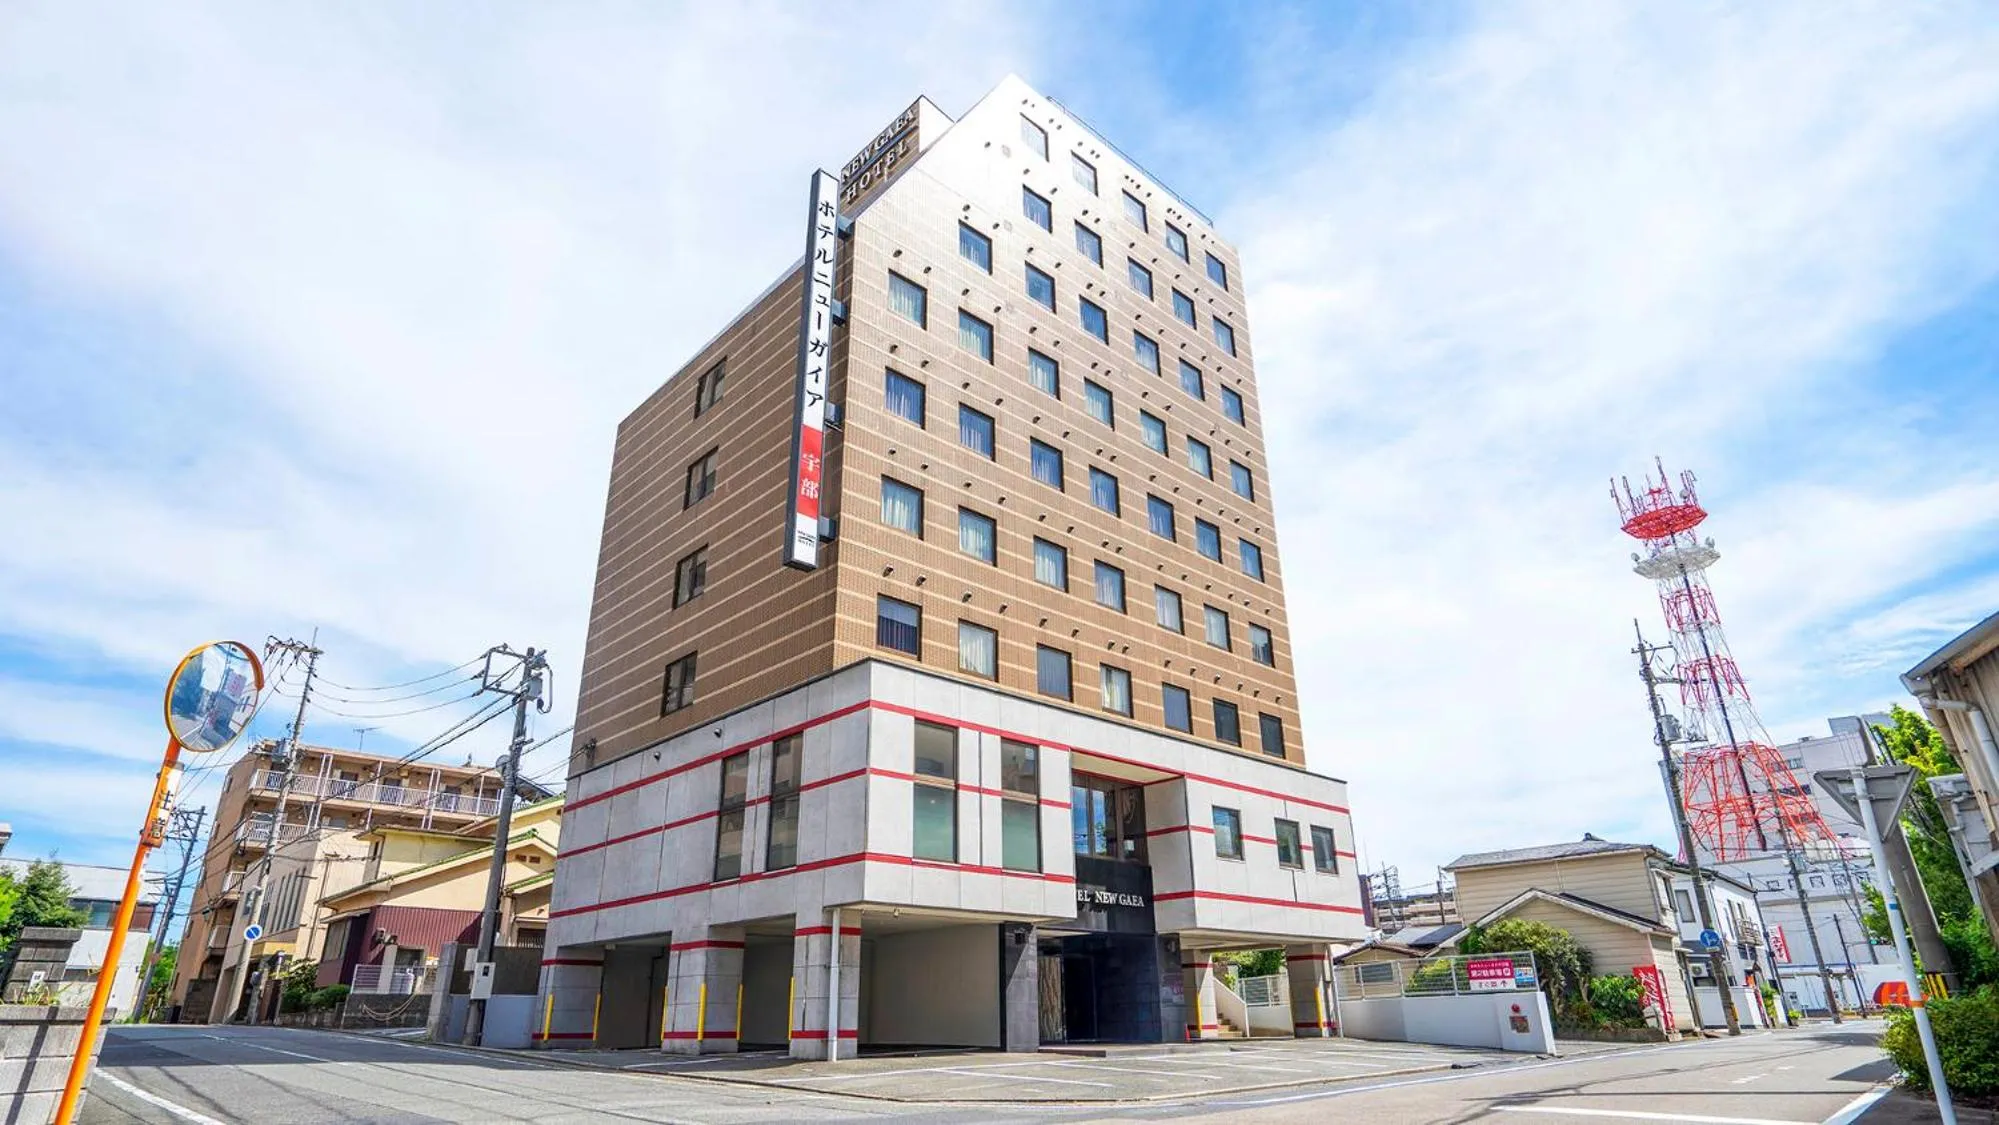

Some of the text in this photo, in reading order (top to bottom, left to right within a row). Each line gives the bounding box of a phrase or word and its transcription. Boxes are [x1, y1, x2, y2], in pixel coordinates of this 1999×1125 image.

[841, 109, 915, 183] NEW GAEA
[845, 139, 909, 201] HOTEL
[806, 201, 835, 407] ホテルニューガイア
[800, 453, 821, 499] 宇部
[1095, 891, 1118, 904] NEW
[1118, 893, 1145, 907] GAEA
